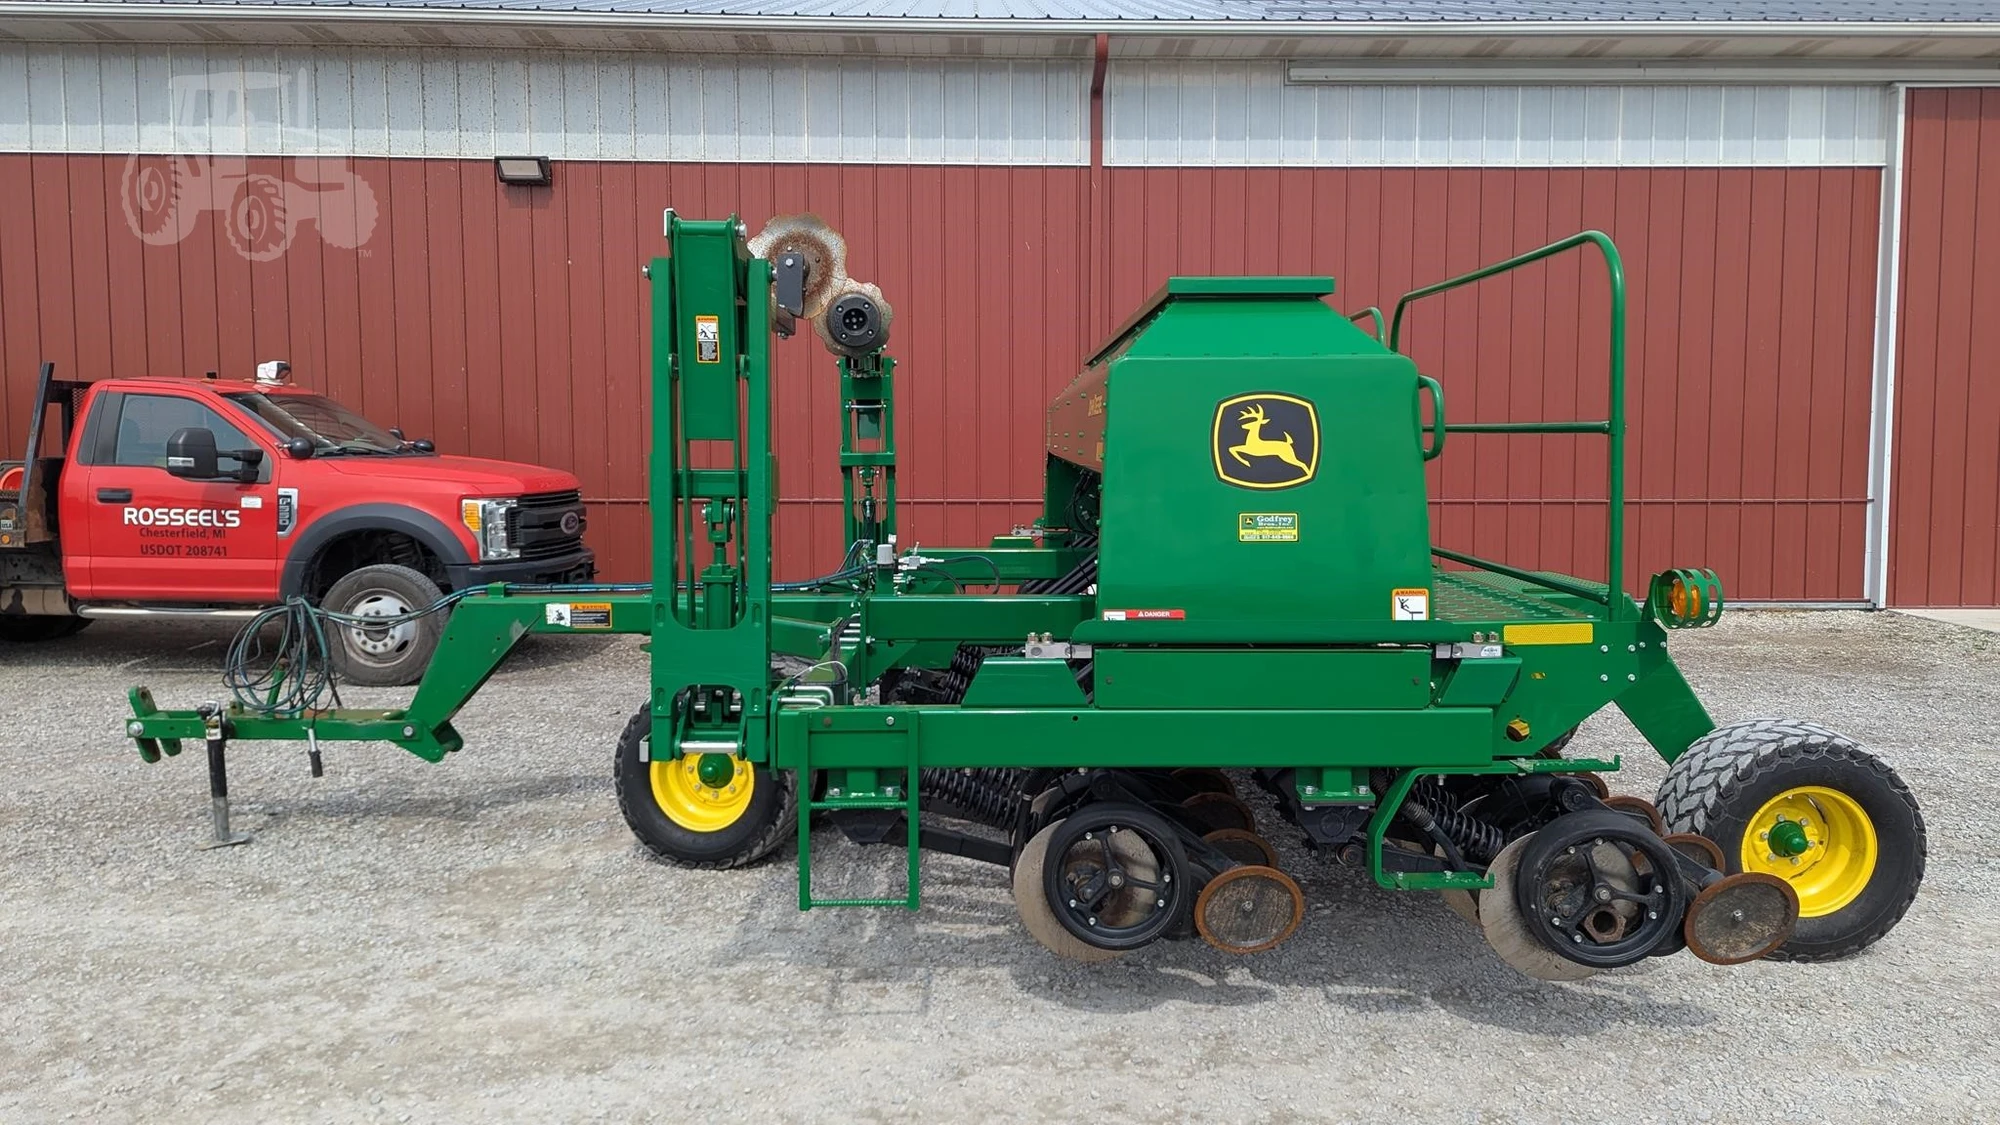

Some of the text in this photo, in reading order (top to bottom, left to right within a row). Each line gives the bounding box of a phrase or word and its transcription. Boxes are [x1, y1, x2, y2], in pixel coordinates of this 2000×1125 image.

[123, 507, 240, 527] ROSSEEL'S
[1256, 515, 1293, 524] Godfrey
[139, 527, 226, 540] Chesterfield, MI
[140, 544, 228, 557] USDOT 208741
